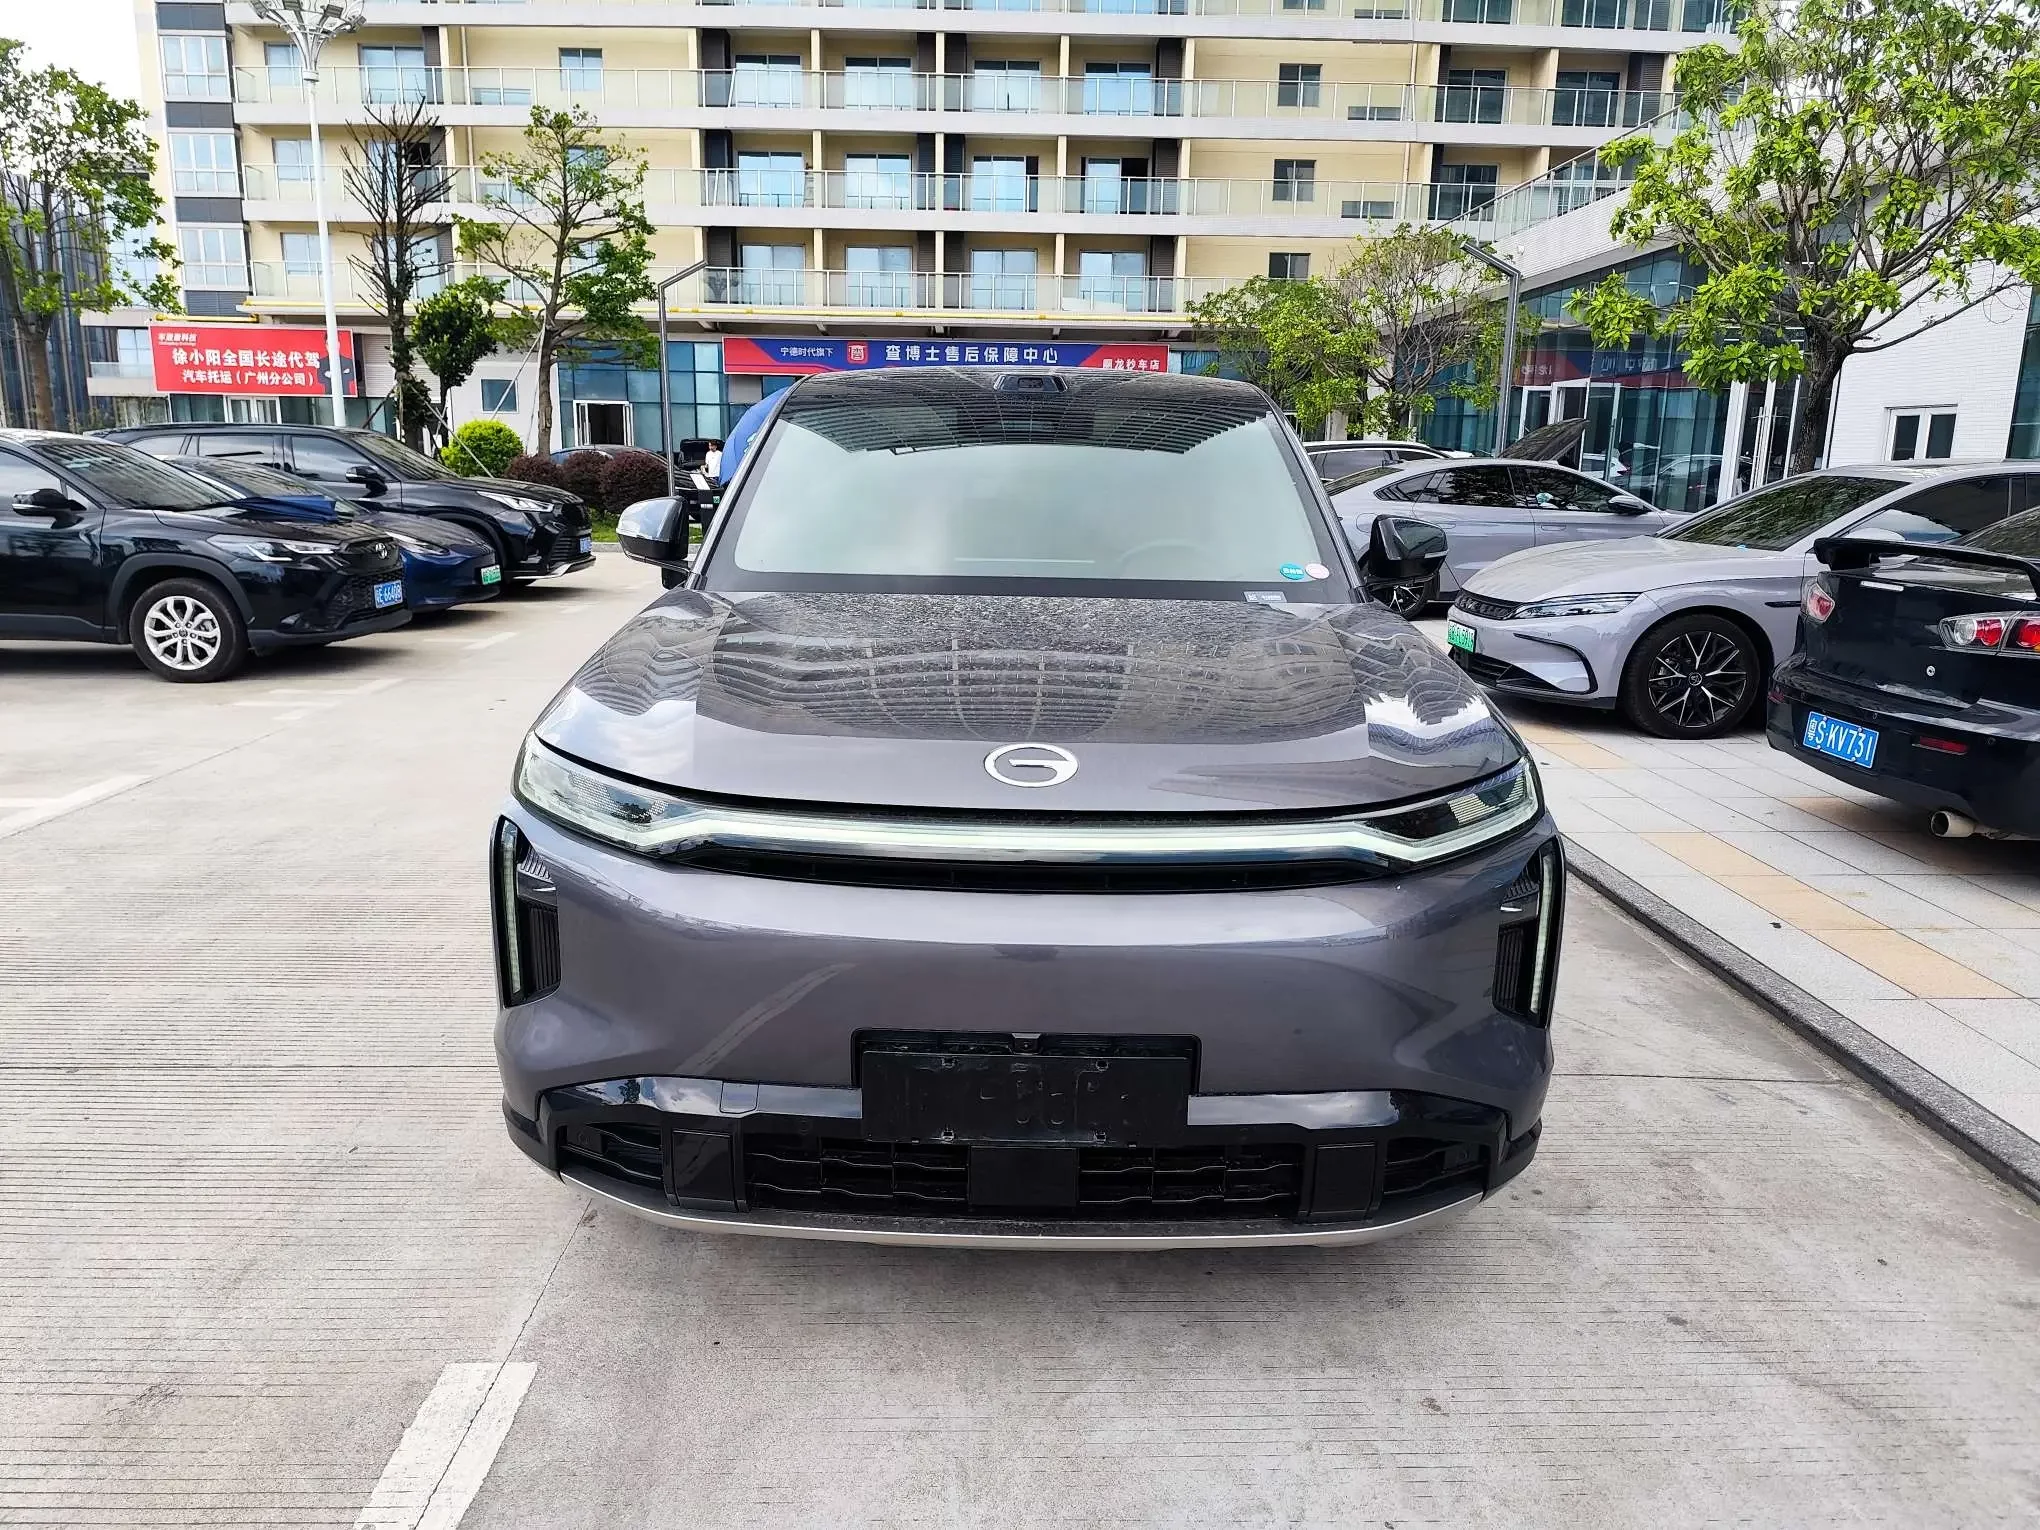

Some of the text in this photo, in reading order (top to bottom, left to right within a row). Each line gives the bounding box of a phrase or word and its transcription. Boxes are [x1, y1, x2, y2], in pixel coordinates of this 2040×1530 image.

[172, 348, 320, 369] 徐小阳全国长途代驾
[780, 346, 833, 357] 宁德时代旗下
[885, 345, 1058, 364] 查博士售后保障中心
[182, 370, 314, 386] 汽车托运（广州分公司）
